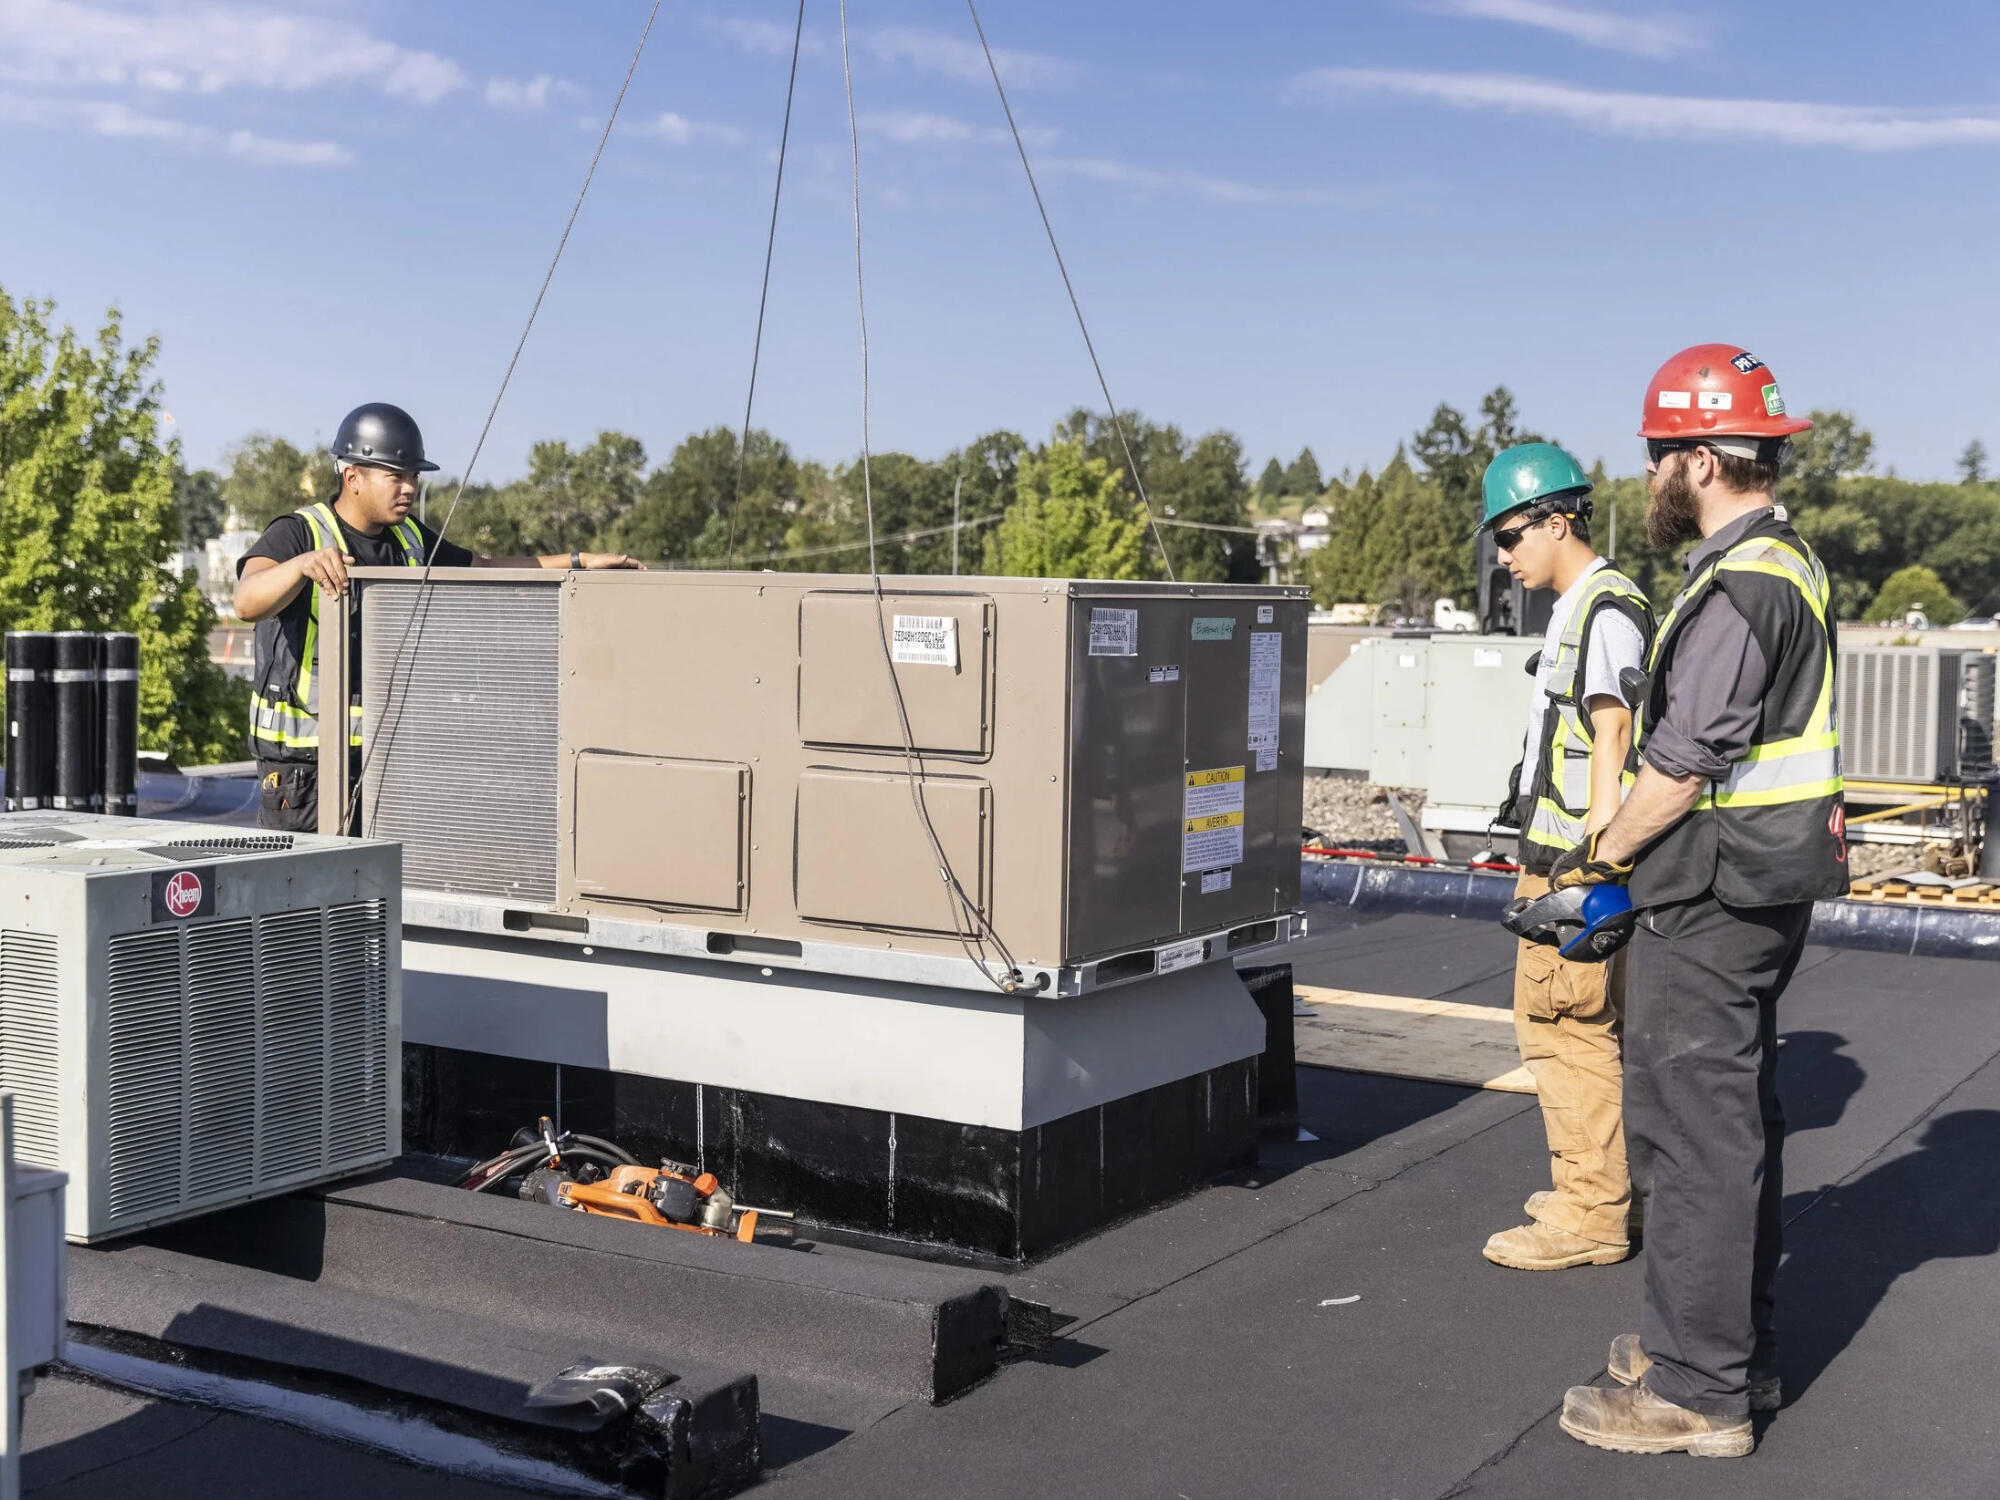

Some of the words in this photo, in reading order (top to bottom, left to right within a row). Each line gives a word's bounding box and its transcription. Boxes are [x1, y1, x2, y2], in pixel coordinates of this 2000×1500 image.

[1206, 771, 1230, 784] CAUTION
[1206, 815, 1229, 828] AVERTIR
[170, 874, 200, 910] Rheem
